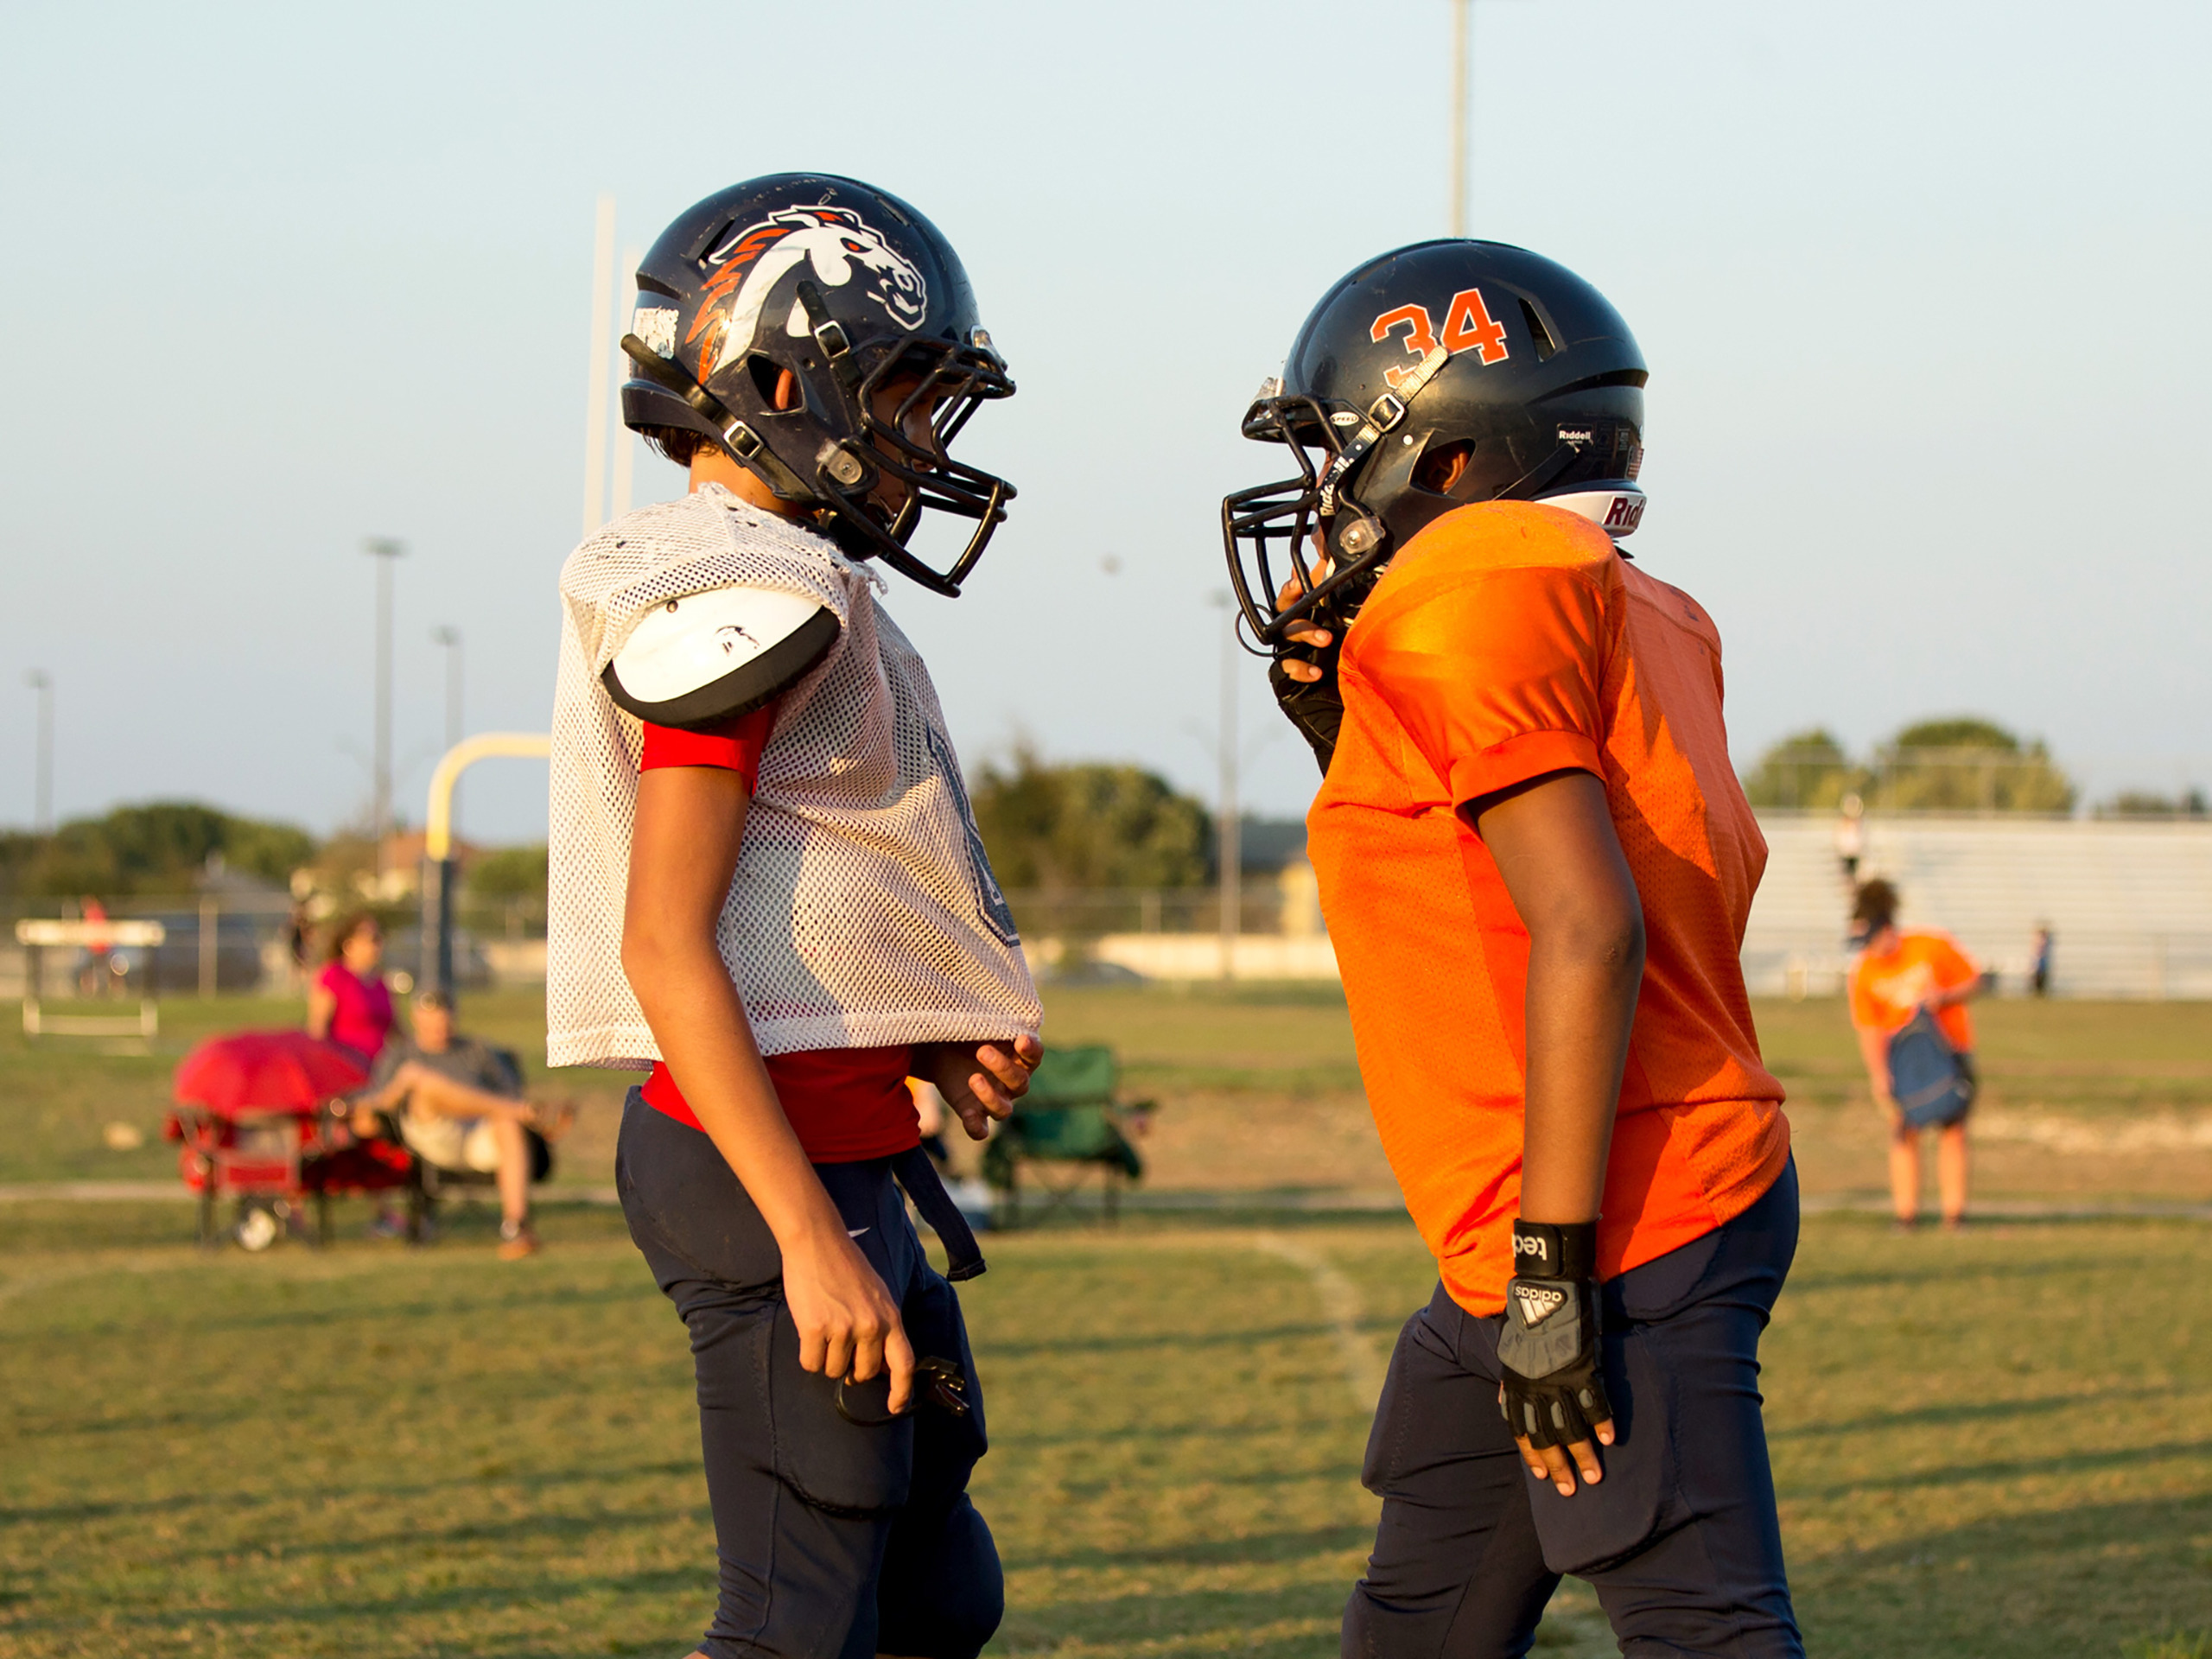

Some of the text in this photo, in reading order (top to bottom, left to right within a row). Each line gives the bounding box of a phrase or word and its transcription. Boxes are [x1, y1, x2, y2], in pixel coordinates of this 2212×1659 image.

[1370, 288, 1510, 390] 34
[1559, 430, 1591, 440] Riddell
[1515, 1286, 1562, 1302] adidas
